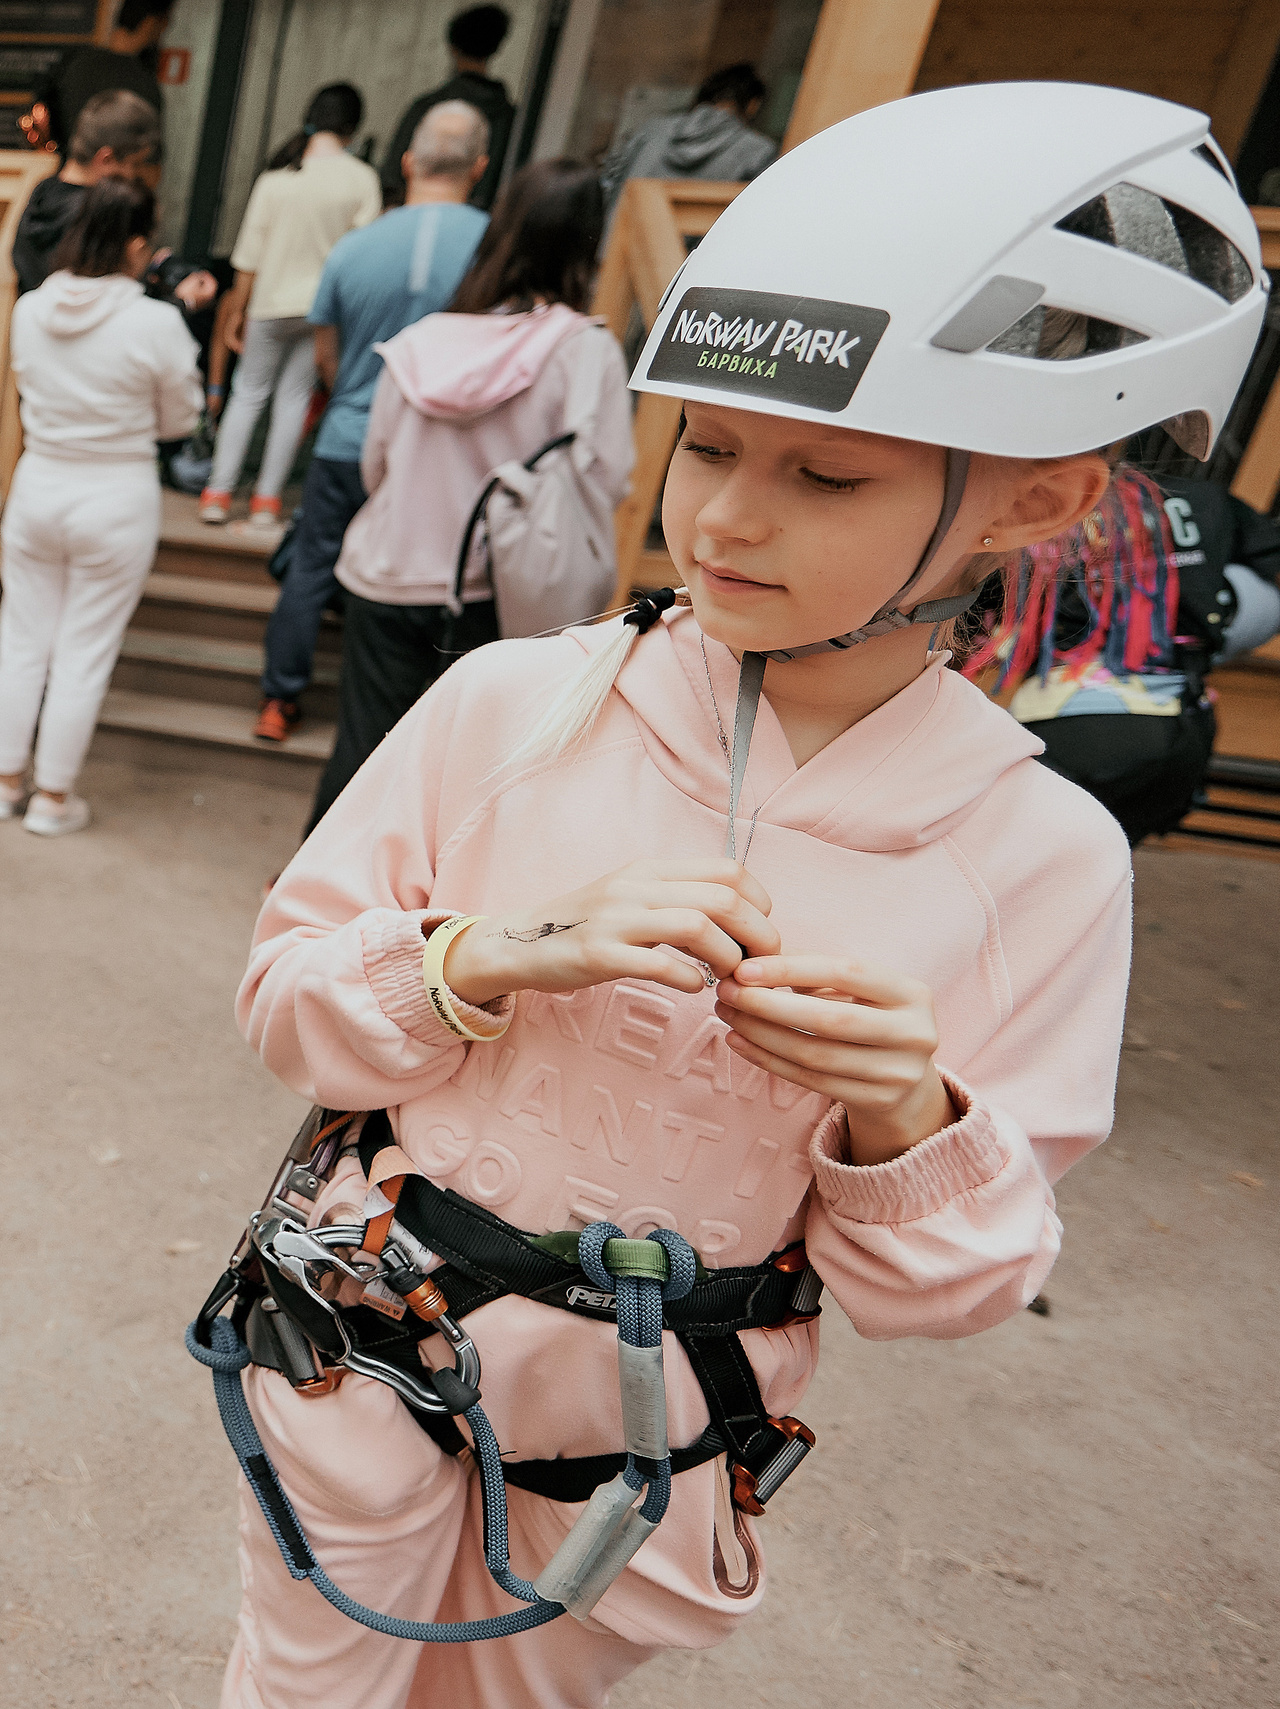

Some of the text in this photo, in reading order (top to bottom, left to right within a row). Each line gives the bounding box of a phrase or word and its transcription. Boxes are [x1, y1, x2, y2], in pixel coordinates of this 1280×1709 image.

[697, 350, 779, 379] БАРВИХА
[770, 319, 861, 369] PARK
[408, 1110, 523, 1207] GO
